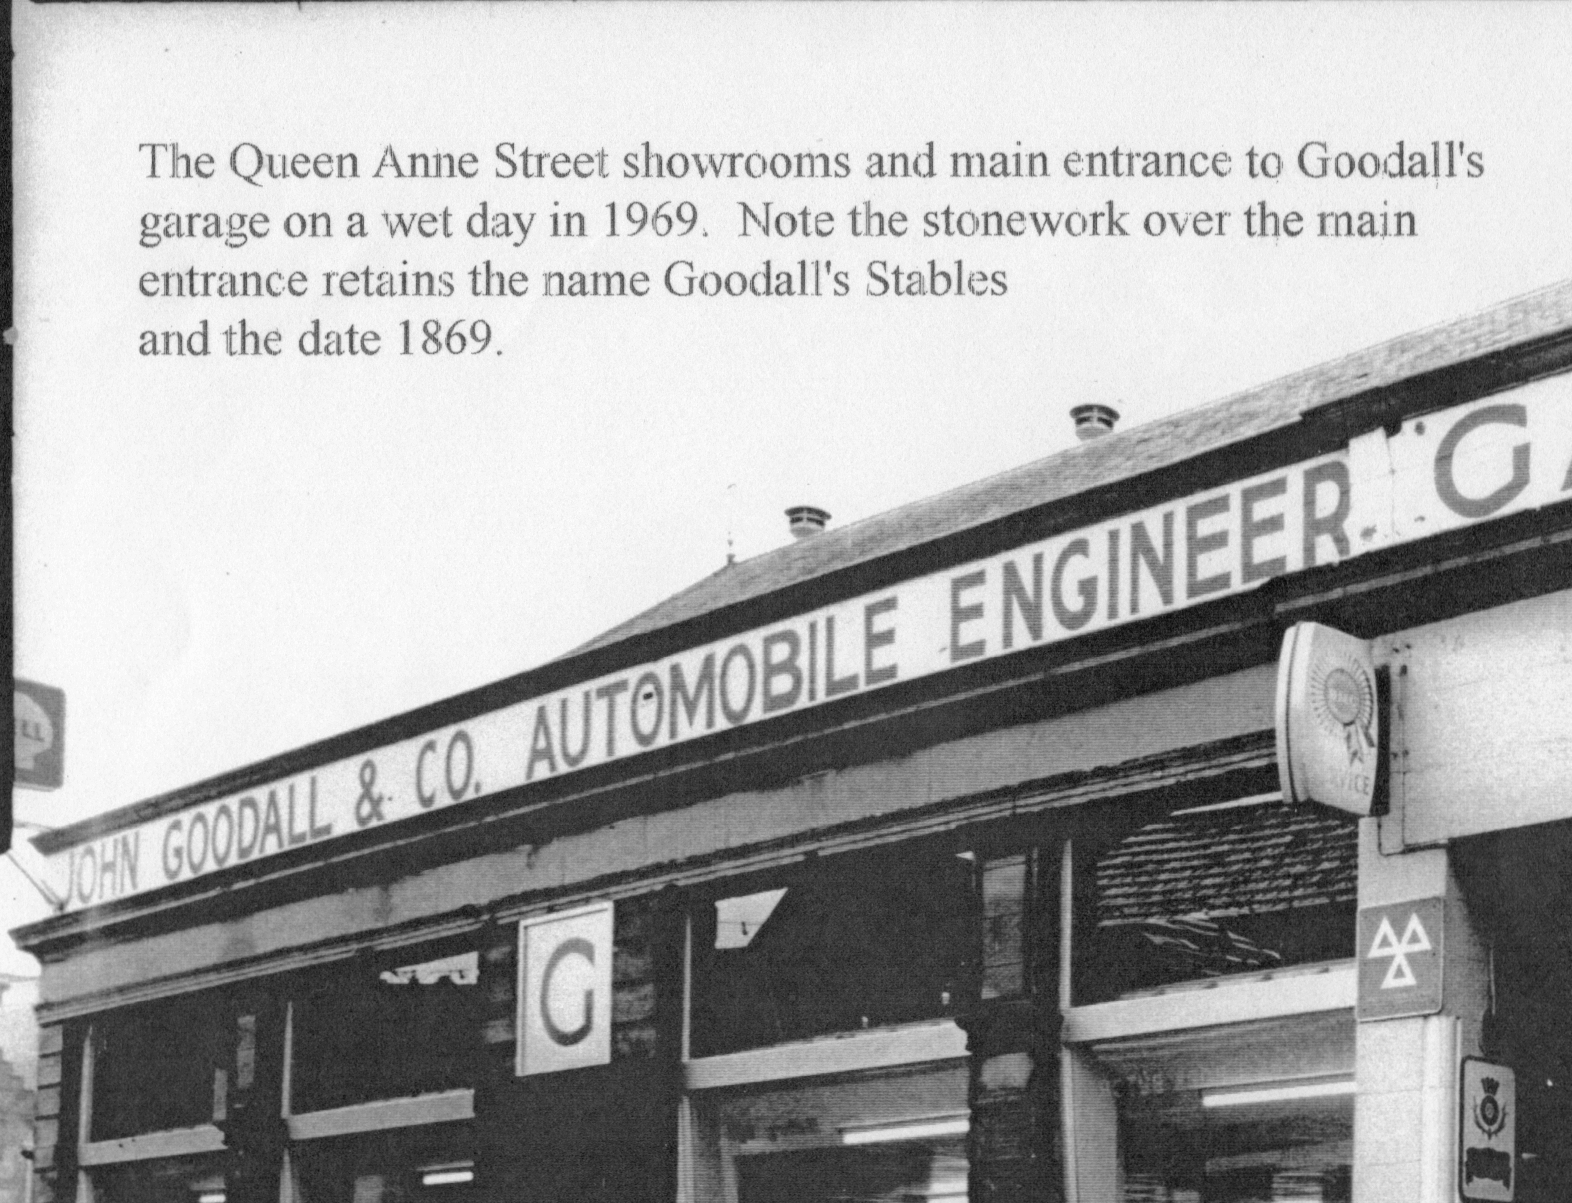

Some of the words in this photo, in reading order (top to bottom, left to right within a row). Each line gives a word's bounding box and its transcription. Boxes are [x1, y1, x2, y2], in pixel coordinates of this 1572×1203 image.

[41, 828, 140, 906] JOHN
[161, 775, 333, 882] GOODALL
[354, 758, 385, 828] &
[414, 729, 483, 810] CO.
[524, 594, 899, 781] AUTOMOBILE
[538, 936, 596, 1048] G
